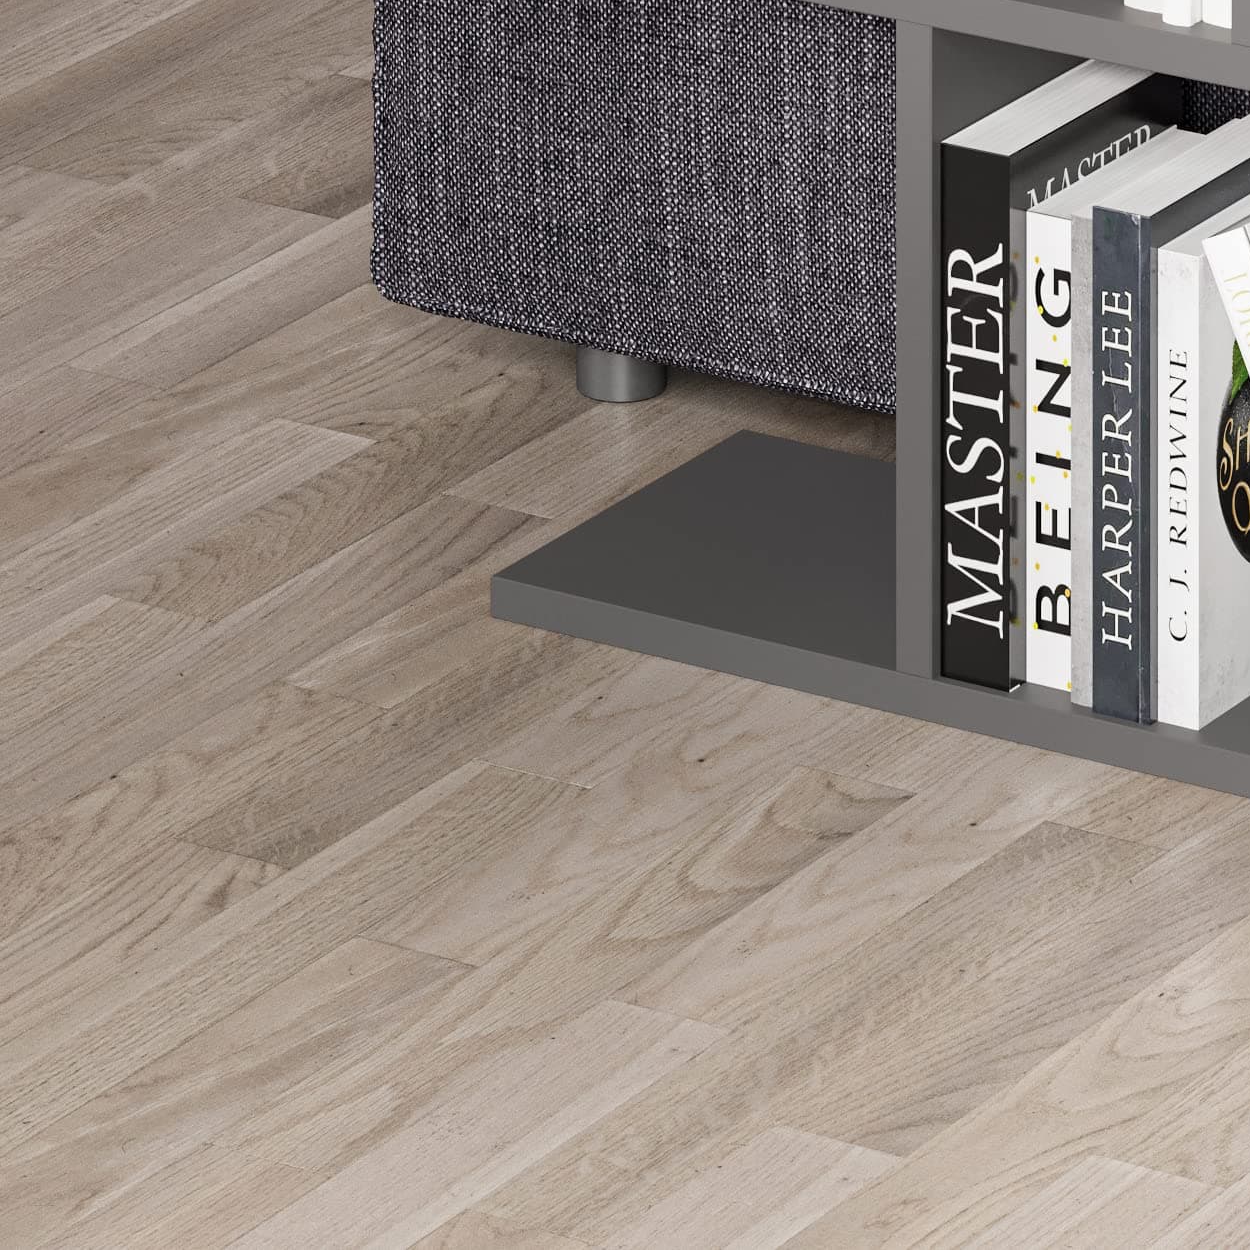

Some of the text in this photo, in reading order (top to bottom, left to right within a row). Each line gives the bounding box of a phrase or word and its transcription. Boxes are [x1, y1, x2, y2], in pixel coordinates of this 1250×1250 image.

[944, 242, 1005, 639] MASTER
[1035, 267, 1071, 636] BEING
[1101, 290, 1133, 651] HARPER LEE
[1168, 348, 1190, 642] C. J. REDWINE
